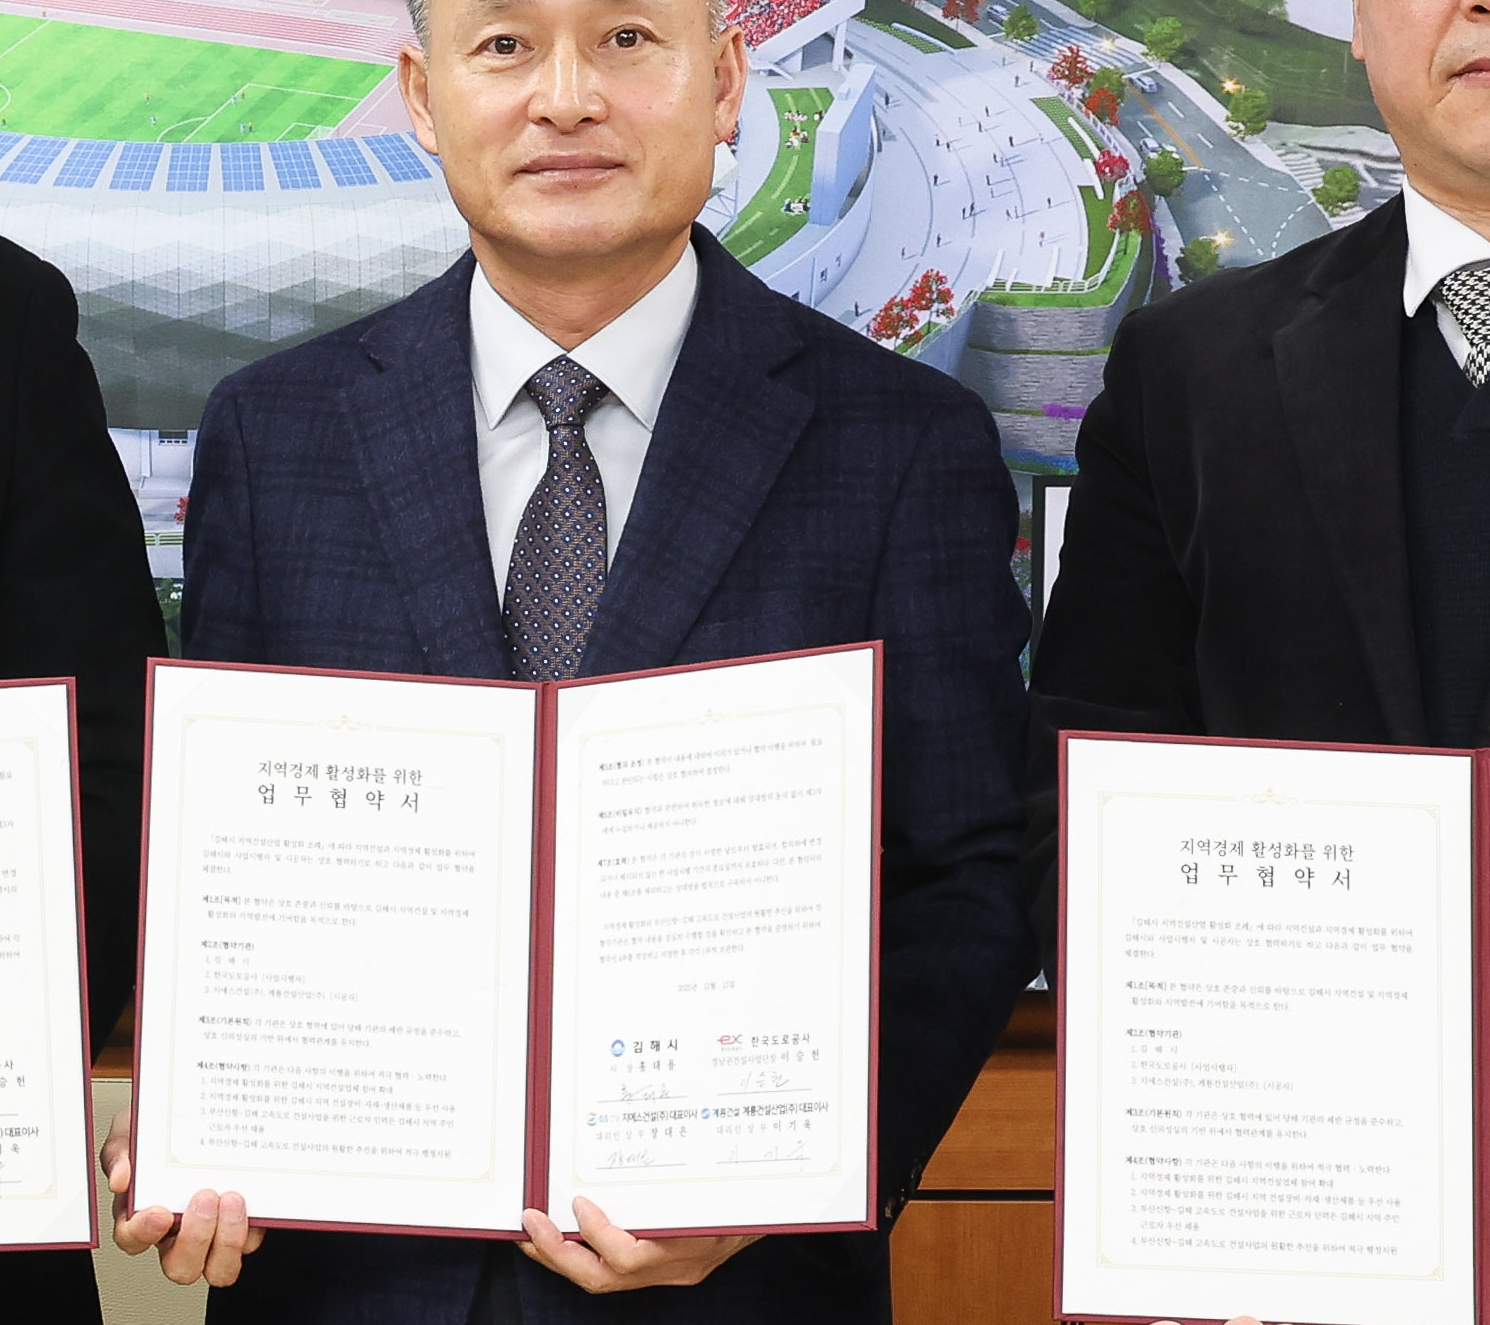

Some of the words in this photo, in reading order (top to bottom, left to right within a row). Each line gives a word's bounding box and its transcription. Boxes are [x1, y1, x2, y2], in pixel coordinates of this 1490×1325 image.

[257, 760, 319, 780] 지역경제
[325, 764, 387, 784] 활성화를
[393, 768, 423, 786] 위한
[1180, 838, 1245, 858] 지역경제
[1251, 840, 1316, 861] 활성화를
[1322, 844, 1355, 862] 위한
[751, 1032, 811, 1047] 한국도로공사
